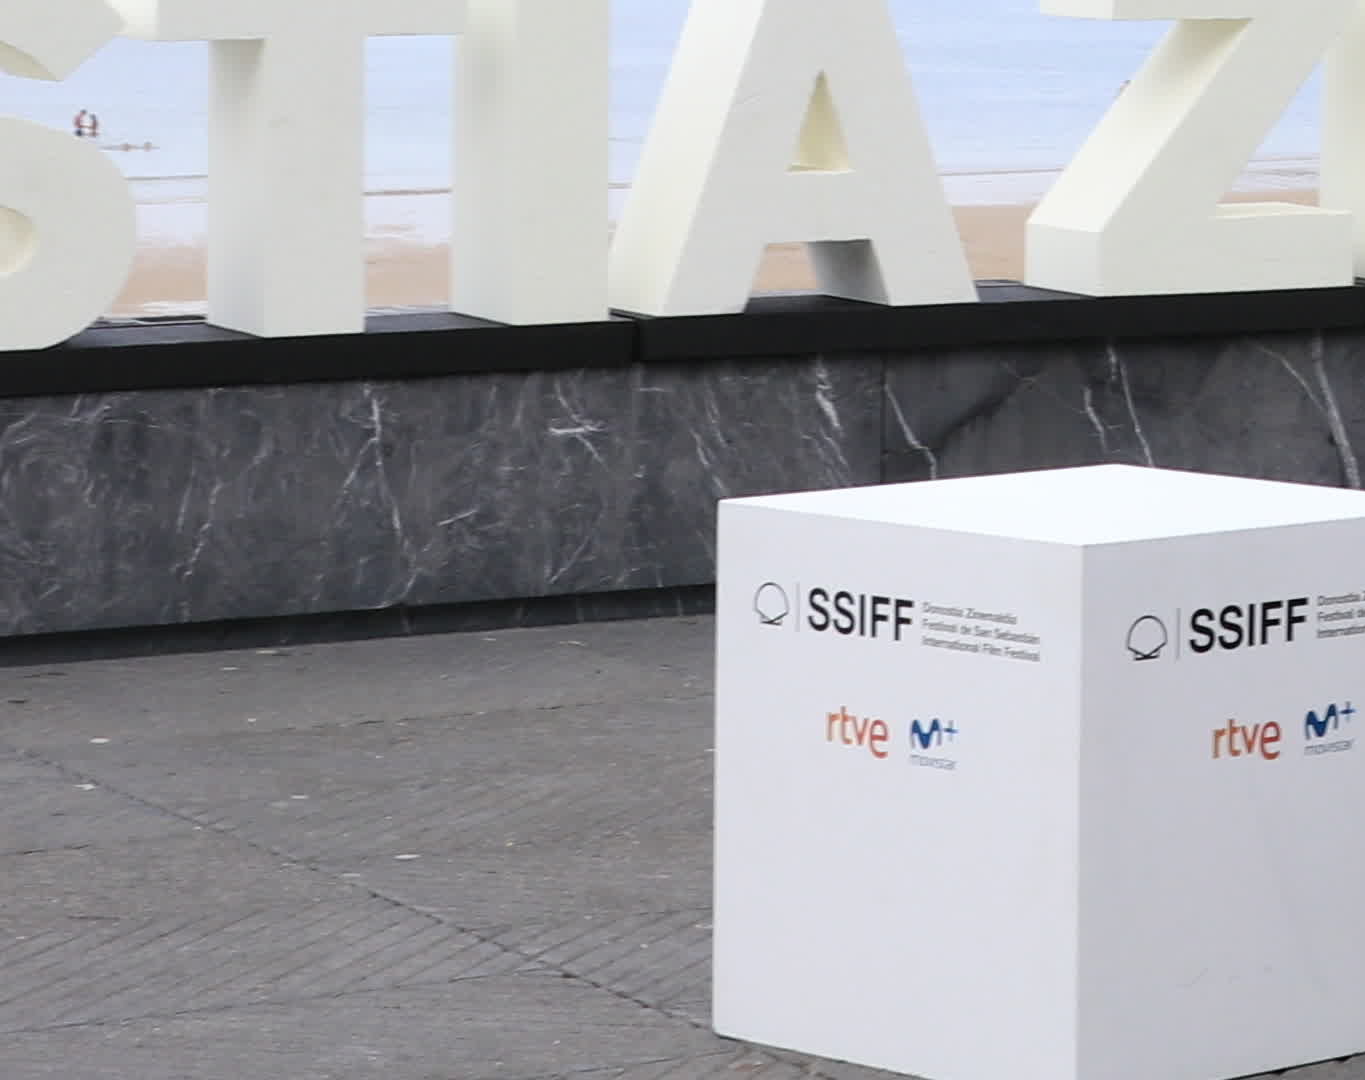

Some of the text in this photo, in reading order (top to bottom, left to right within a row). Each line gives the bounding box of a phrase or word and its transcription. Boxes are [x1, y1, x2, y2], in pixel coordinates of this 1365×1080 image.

[807, 587, 914, 641] SSIFF
[1189, 596, 1309, 653] SSIFF
[825, 705, 889, 758] rtve
[1212, 718, 1281, 760] rtve
